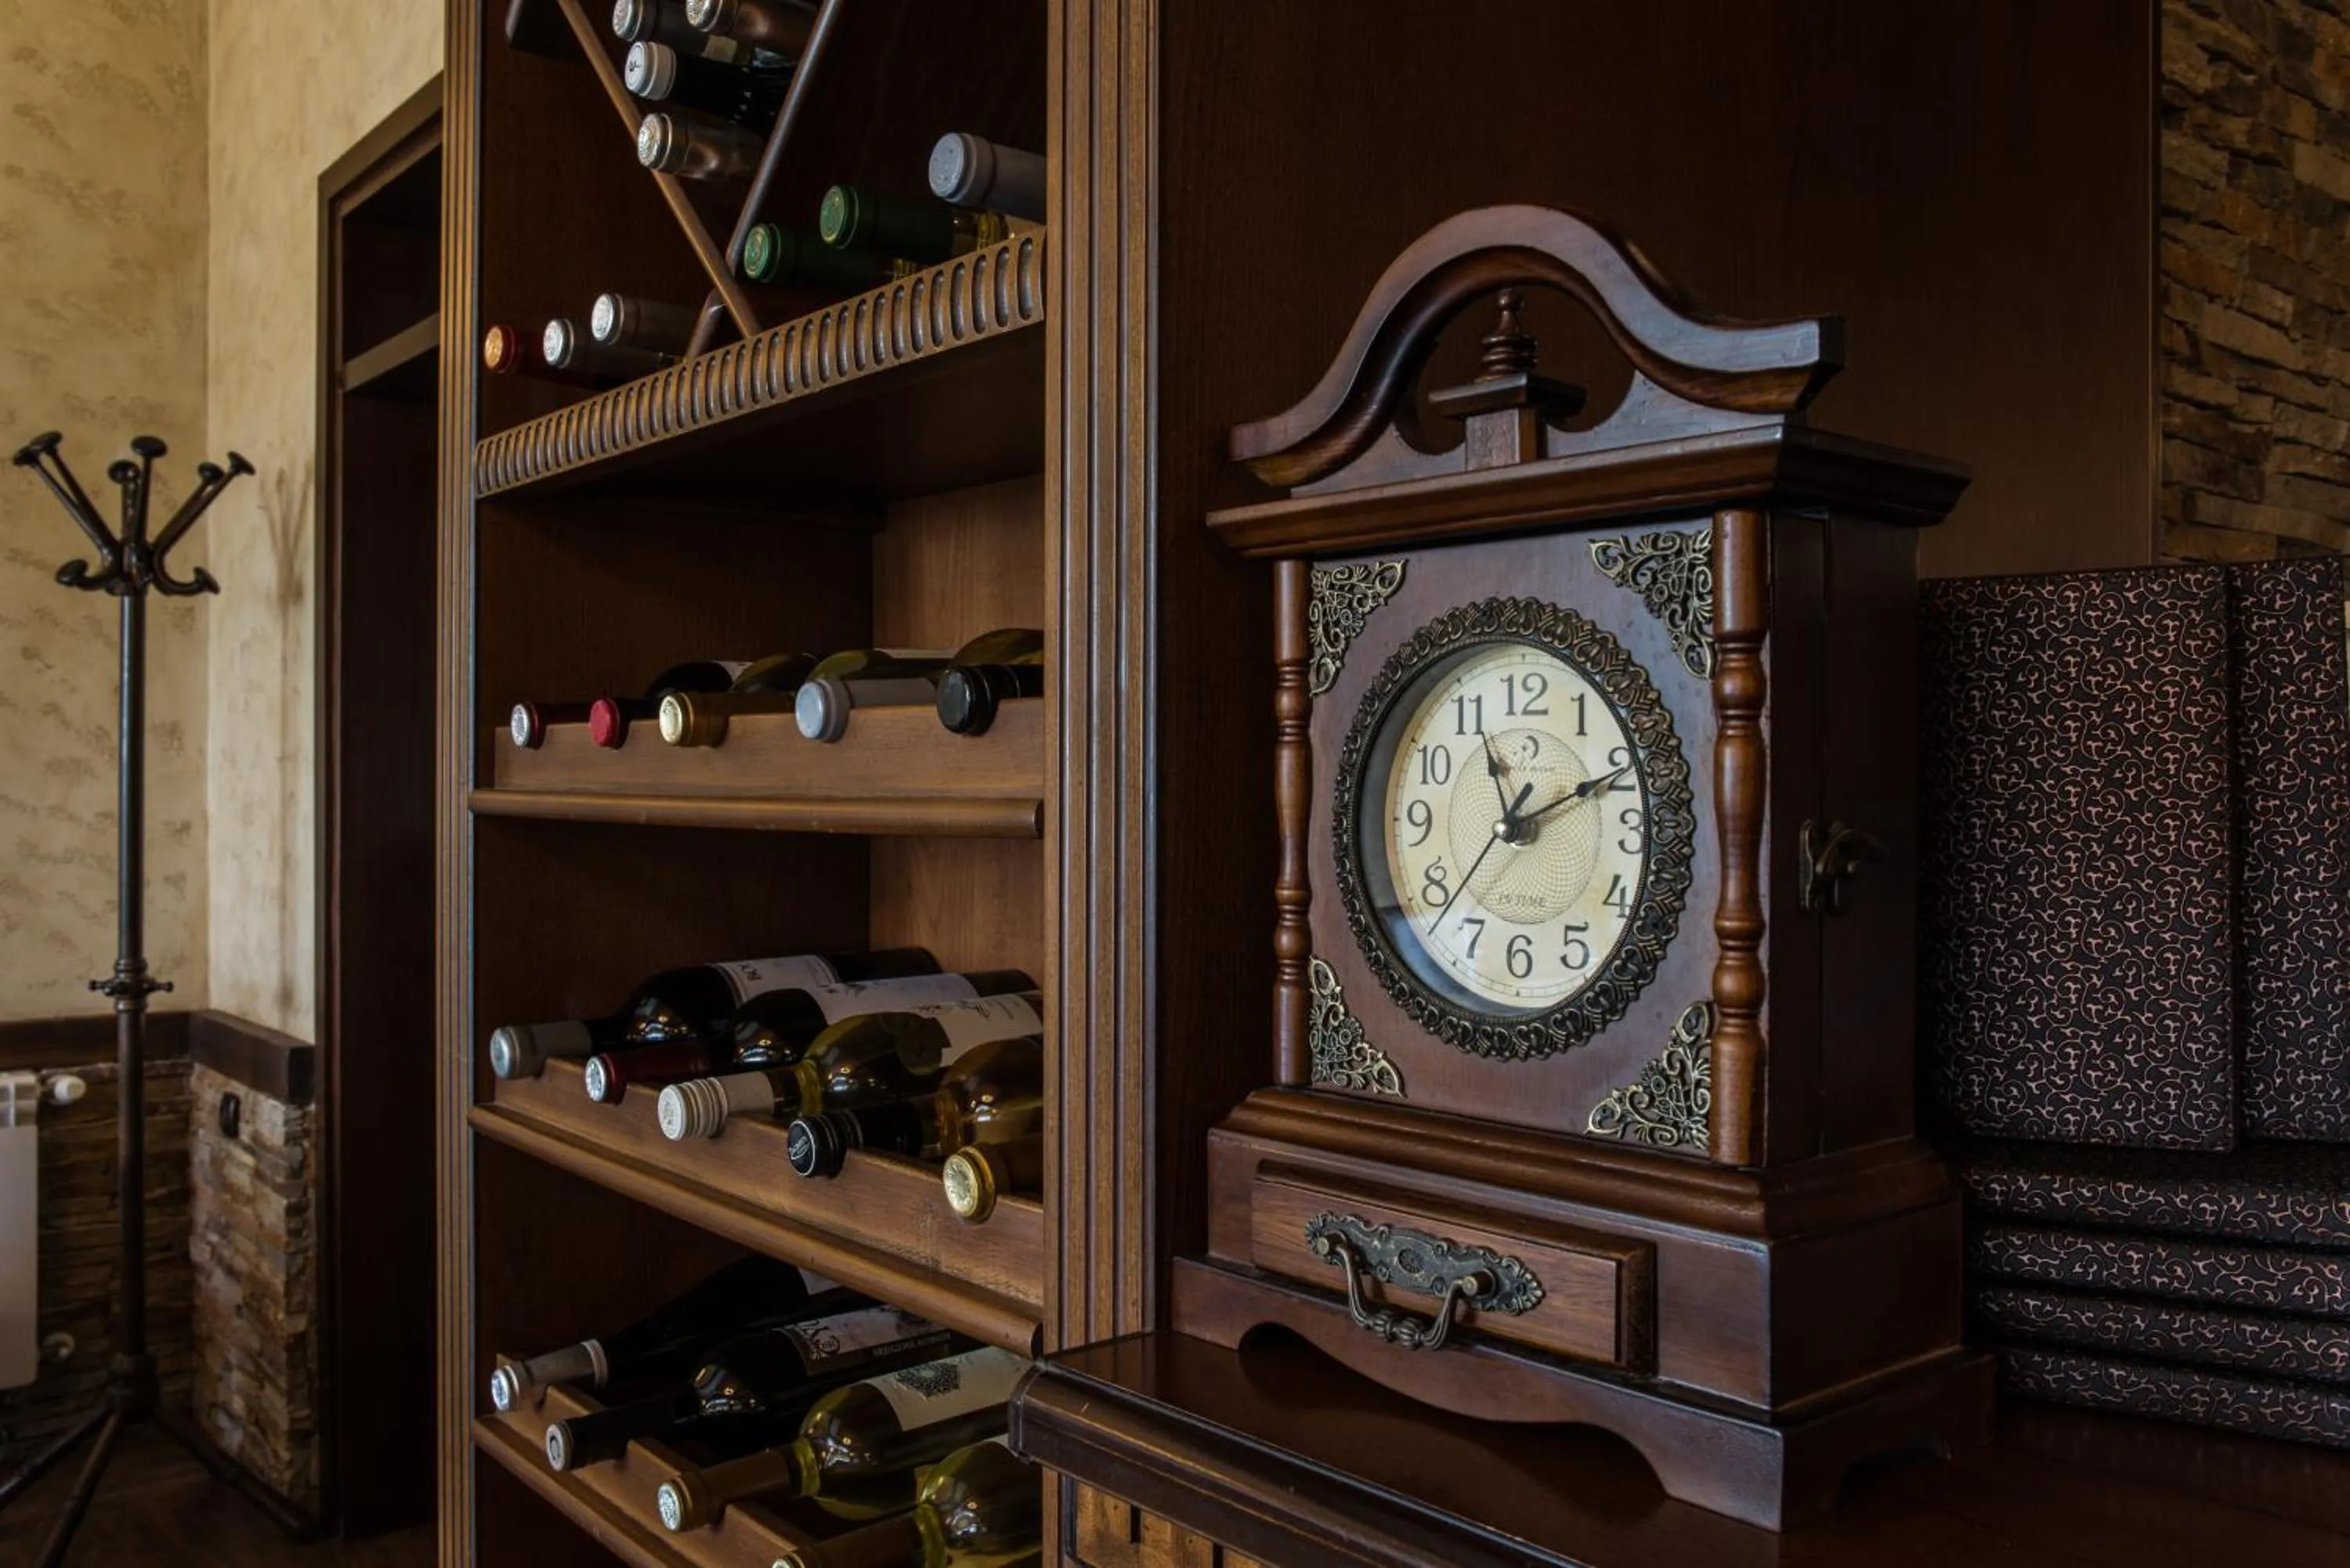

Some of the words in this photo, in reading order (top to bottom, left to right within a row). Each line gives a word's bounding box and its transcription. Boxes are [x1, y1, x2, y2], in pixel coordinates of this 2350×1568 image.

[1452, 694, 1483, 736] 11
[1500, 673, 1549, 717] 12
[1570, 693, 1588, 737] 1
[1417, 744, 1452, 786] 10
[1607, 746, 1636, 791] 2
[1407, 800, 1433, 847] 9
[1618, 808, 1643, 854] 3
[1422, 855, 1449, 907] 8
[1602, 874, 1632, 918] 4
[1458, 917, 1485, 959] 7
[1506, 934, 1533, 979] 6
[1560, 921, 1589, 970] 5
